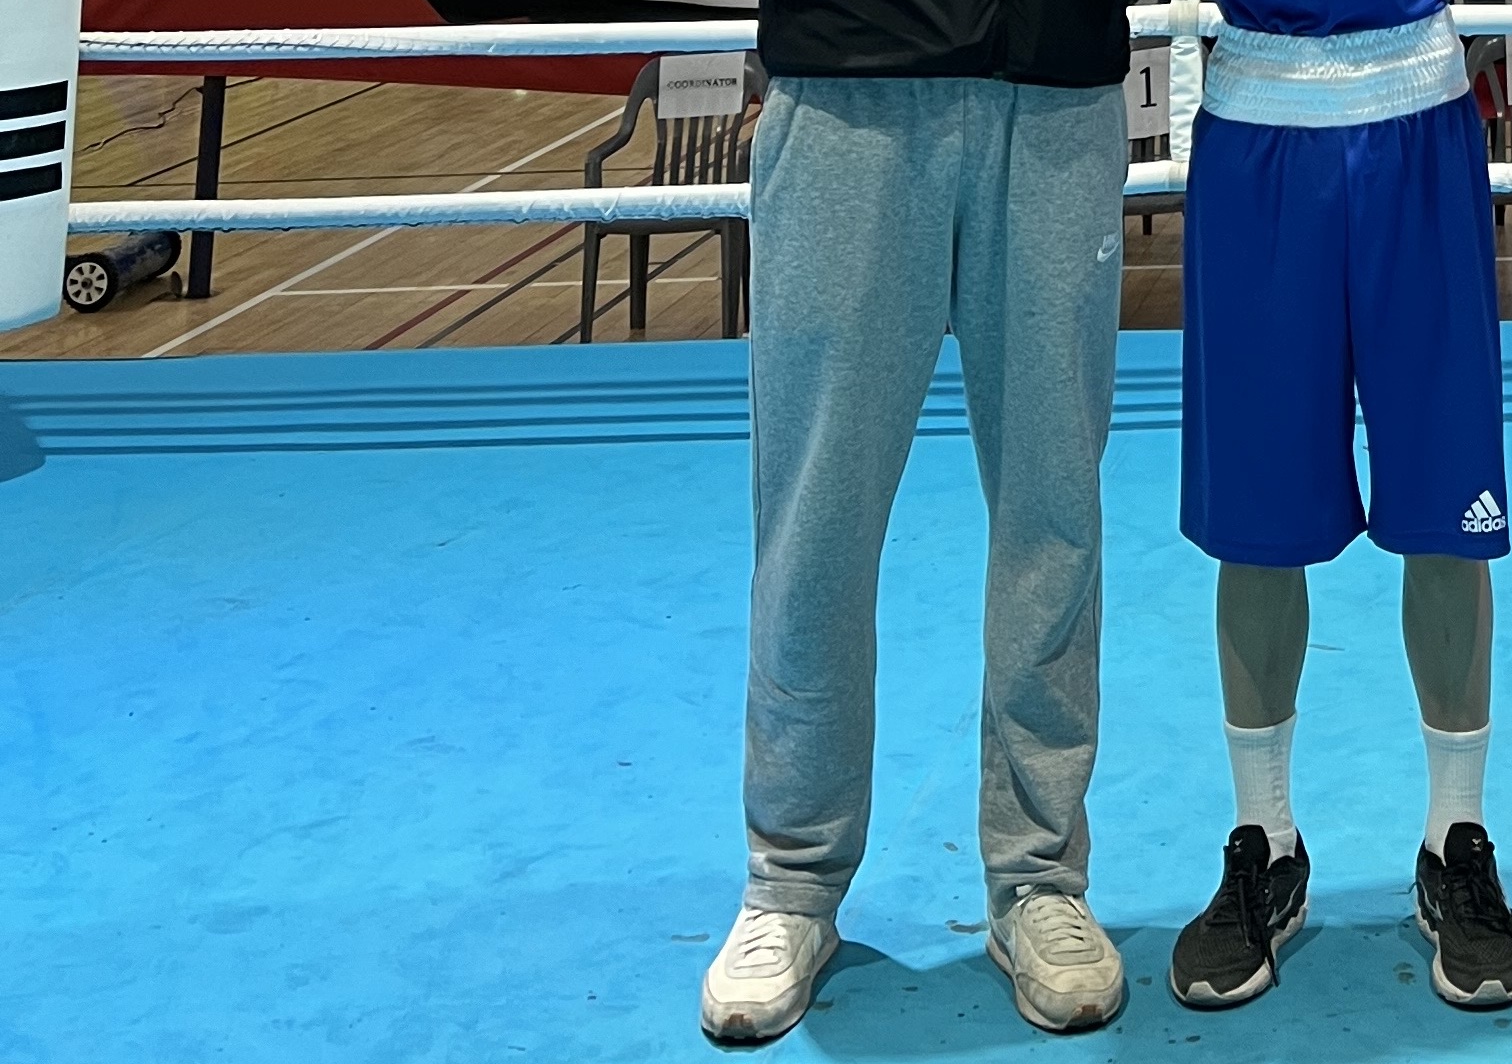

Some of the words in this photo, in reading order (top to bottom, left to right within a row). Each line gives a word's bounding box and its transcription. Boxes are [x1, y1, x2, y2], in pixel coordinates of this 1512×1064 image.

[666, 77, 738, 91] COORDINATOR
[1139, 66, 1158, 109] 1
[1461, 516, 1506, 533] adidas
